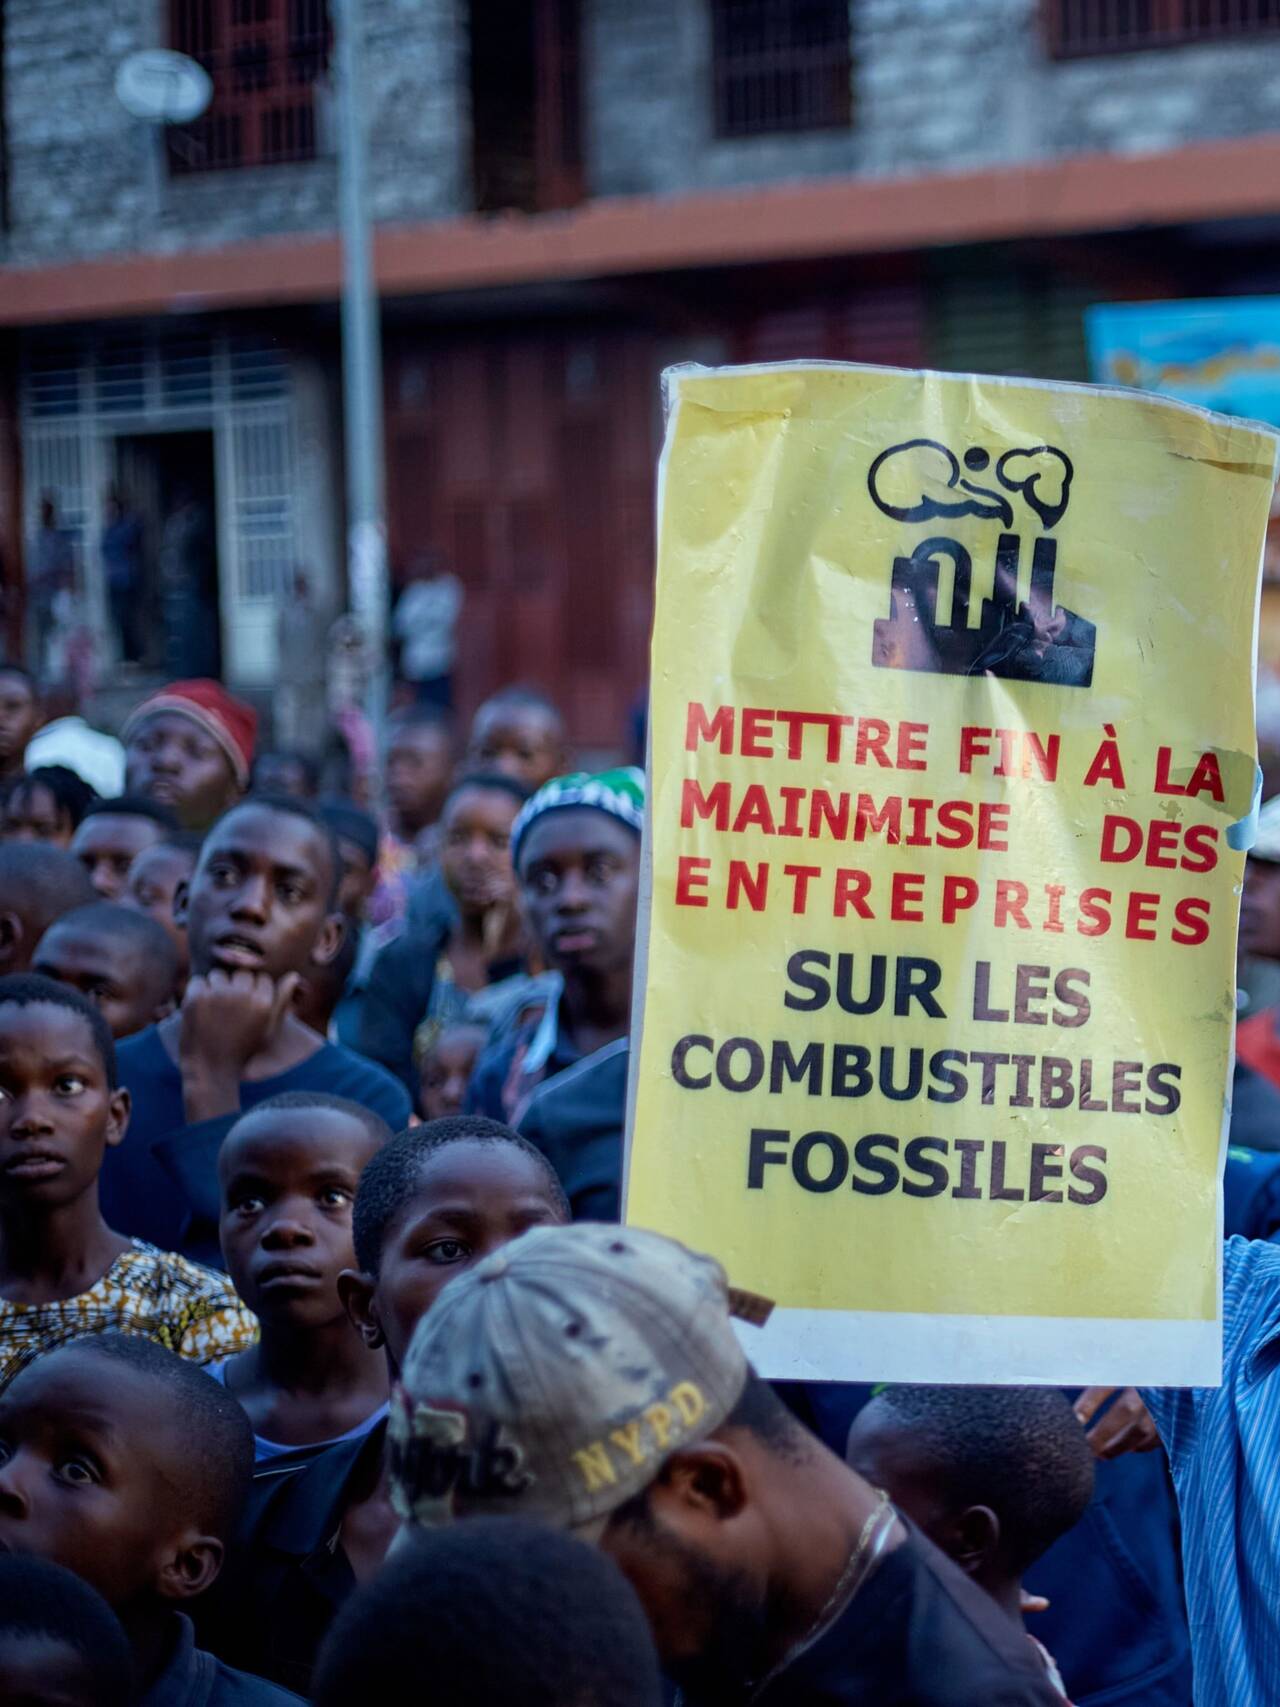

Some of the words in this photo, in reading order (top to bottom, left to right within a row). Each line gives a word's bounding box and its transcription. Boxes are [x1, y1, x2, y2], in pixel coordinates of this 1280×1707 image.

[685, 703, 929, 772] METTRE
[960, 727, 1061, 782] FIN
[1084, 724, 1126, 790] À
[1154, 747, 1224, 801] LA
[679, 779, 1010, 852] MAINMISE
[1100, 815, 1219, 873] DES
[674, 856, 1211, 945] ENTREPRISES
[784, 949, 948, 1020] SUR
[972, 960, 1092, 1028] LES
[670, 1033, 1183, 1116] COMBUSTIBLES
[747, 1127, 1109, 1206] FOSSILES
